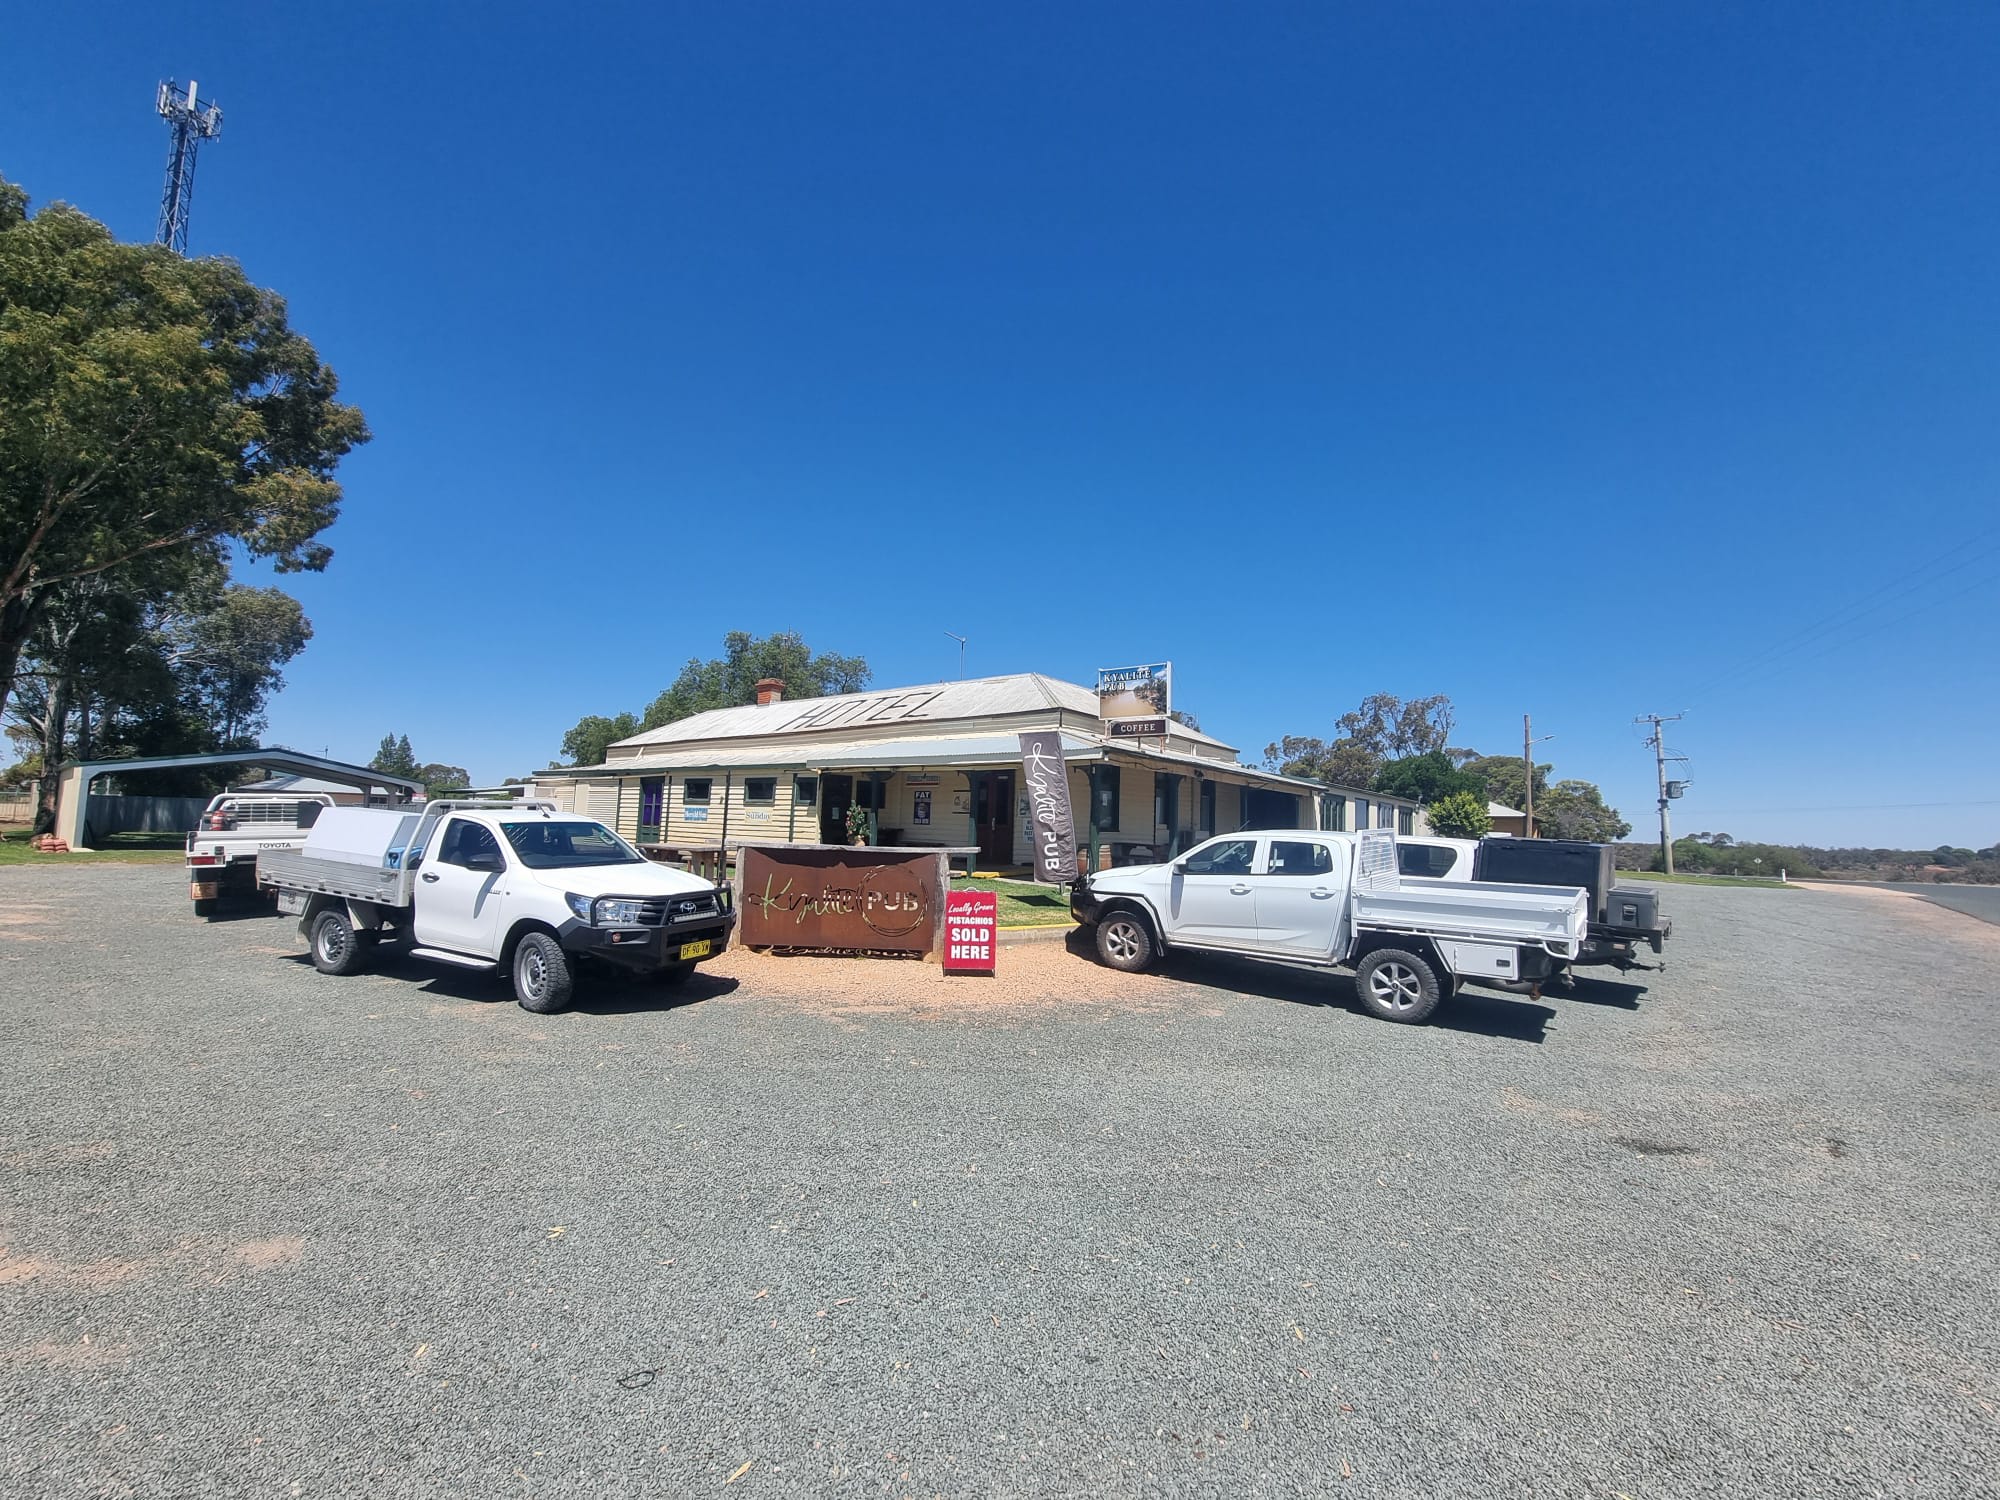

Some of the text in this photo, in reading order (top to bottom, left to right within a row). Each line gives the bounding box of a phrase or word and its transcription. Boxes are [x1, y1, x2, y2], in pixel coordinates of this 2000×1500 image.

[1103, 669, 1151, 682] KYALITE
[1103, 681, 1126, 692] PUB
[775, 691, 944, 732] HOTEL
[1120, 723, 1156, 733] COFFEE
[1024, 742, 1058, 824] Kyalite
[1042, 831, 1060, 871] PUB
[748, 873, 919, 925] Kyalite PUB
[948, 901, 994, 915] Locally Grown
[948, 916, 994, 926] PISTACHIOS
[951, 927, 990, 942] SOLD
[950, 944, 990, 960] HERE
